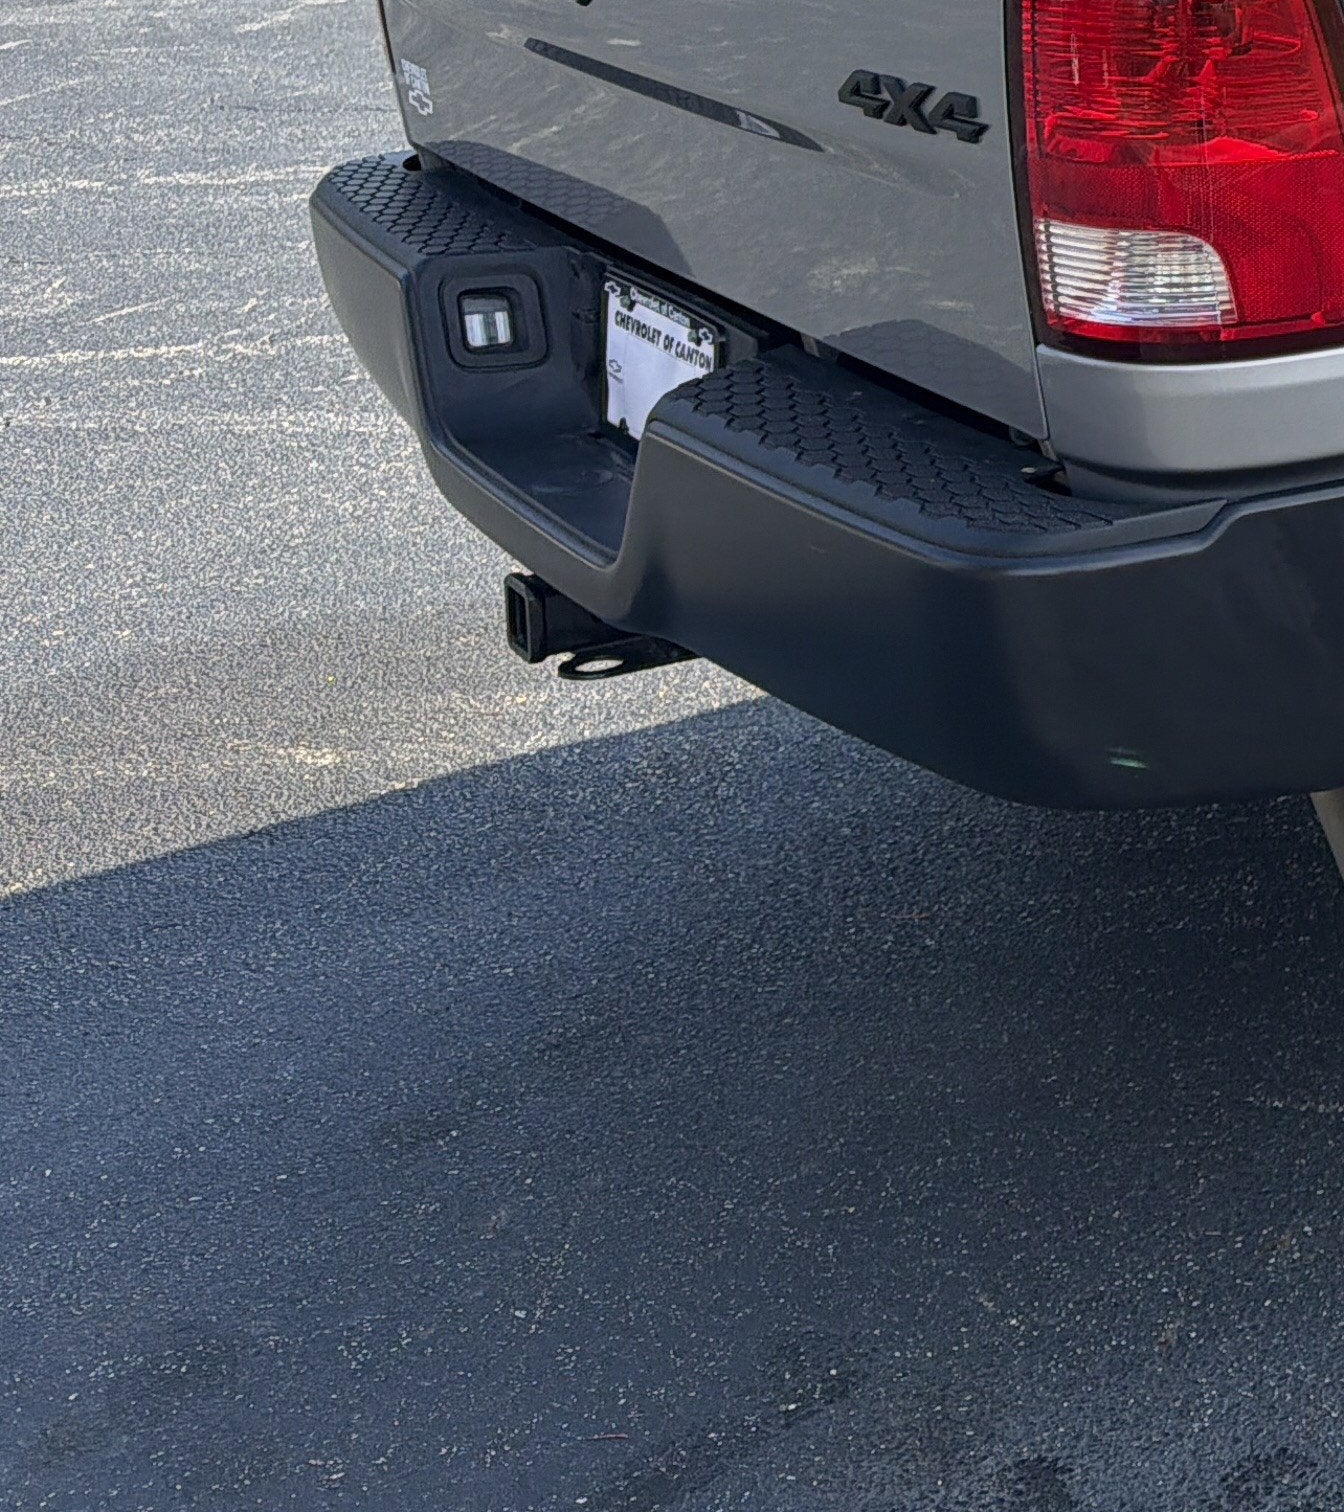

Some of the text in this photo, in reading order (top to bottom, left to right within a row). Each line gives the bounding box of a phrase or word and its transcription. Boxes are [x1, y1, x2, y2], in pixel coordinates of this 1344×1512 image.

[838, 69, 990, 144] 4X4
[614, 310, 713, 373] CHEVROLET OF CANTON
